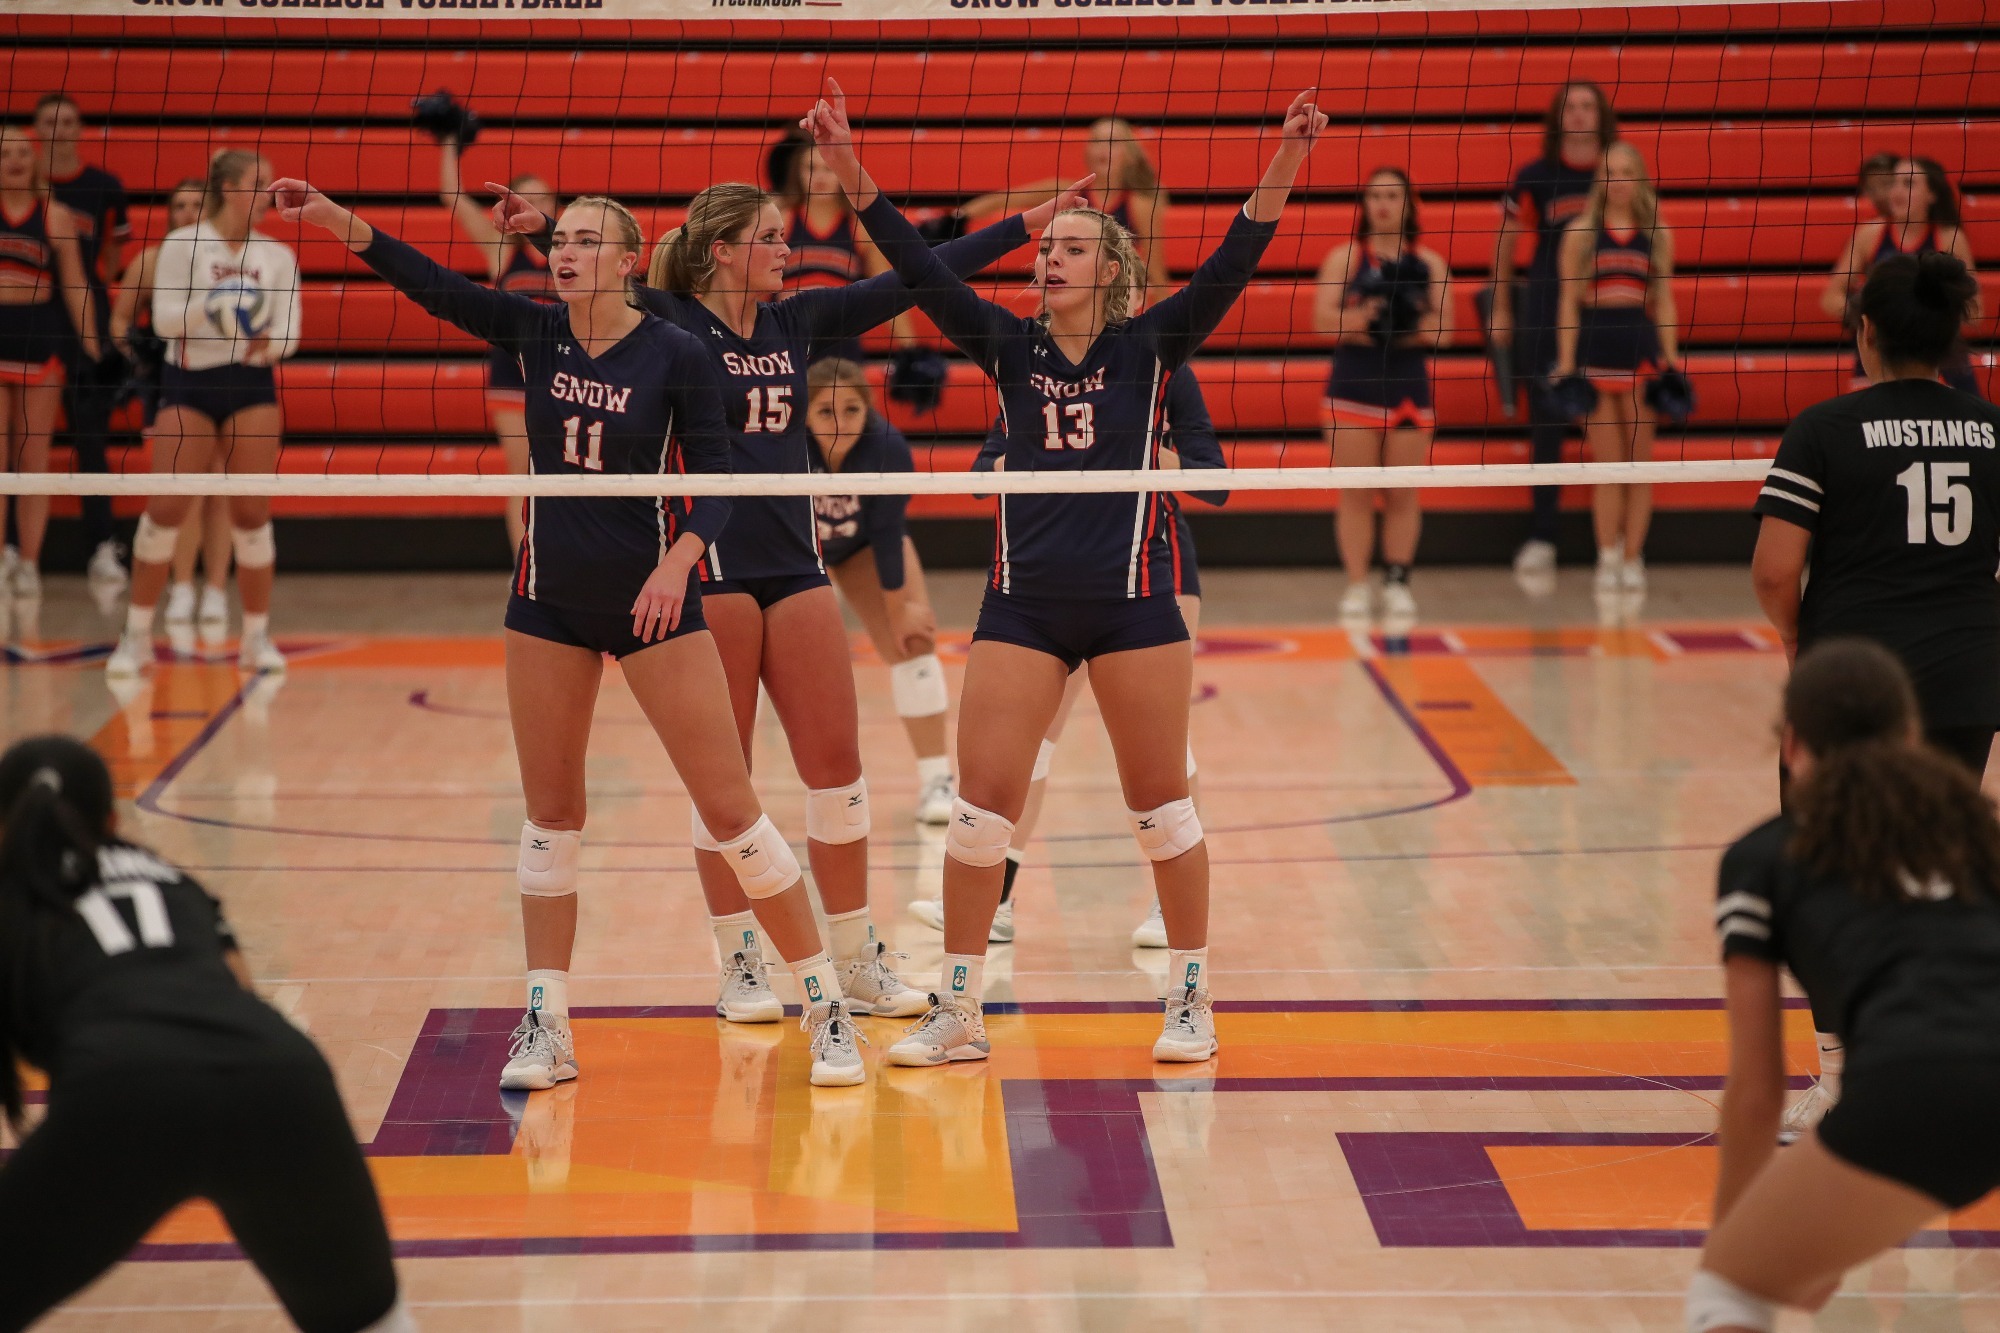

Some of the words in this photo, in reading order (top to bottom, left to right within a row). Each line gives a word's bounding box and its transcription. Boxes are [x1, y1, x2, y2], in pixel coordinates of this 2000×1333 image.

[722, 350, 796, 377] SNOW
[1029, 365, 1106, 399] SNOW
[550, 371, 632, 414] SNOW
[743, 384, 793, 434] 15
[562, 415, 604, 472] 11
[1042, 401, 1096, 451] 13
[1861, 419, 1996, 450] MUSTANGS
[1896, 461, 1973, 546] 15
[73, 880, 176, 957] 17
